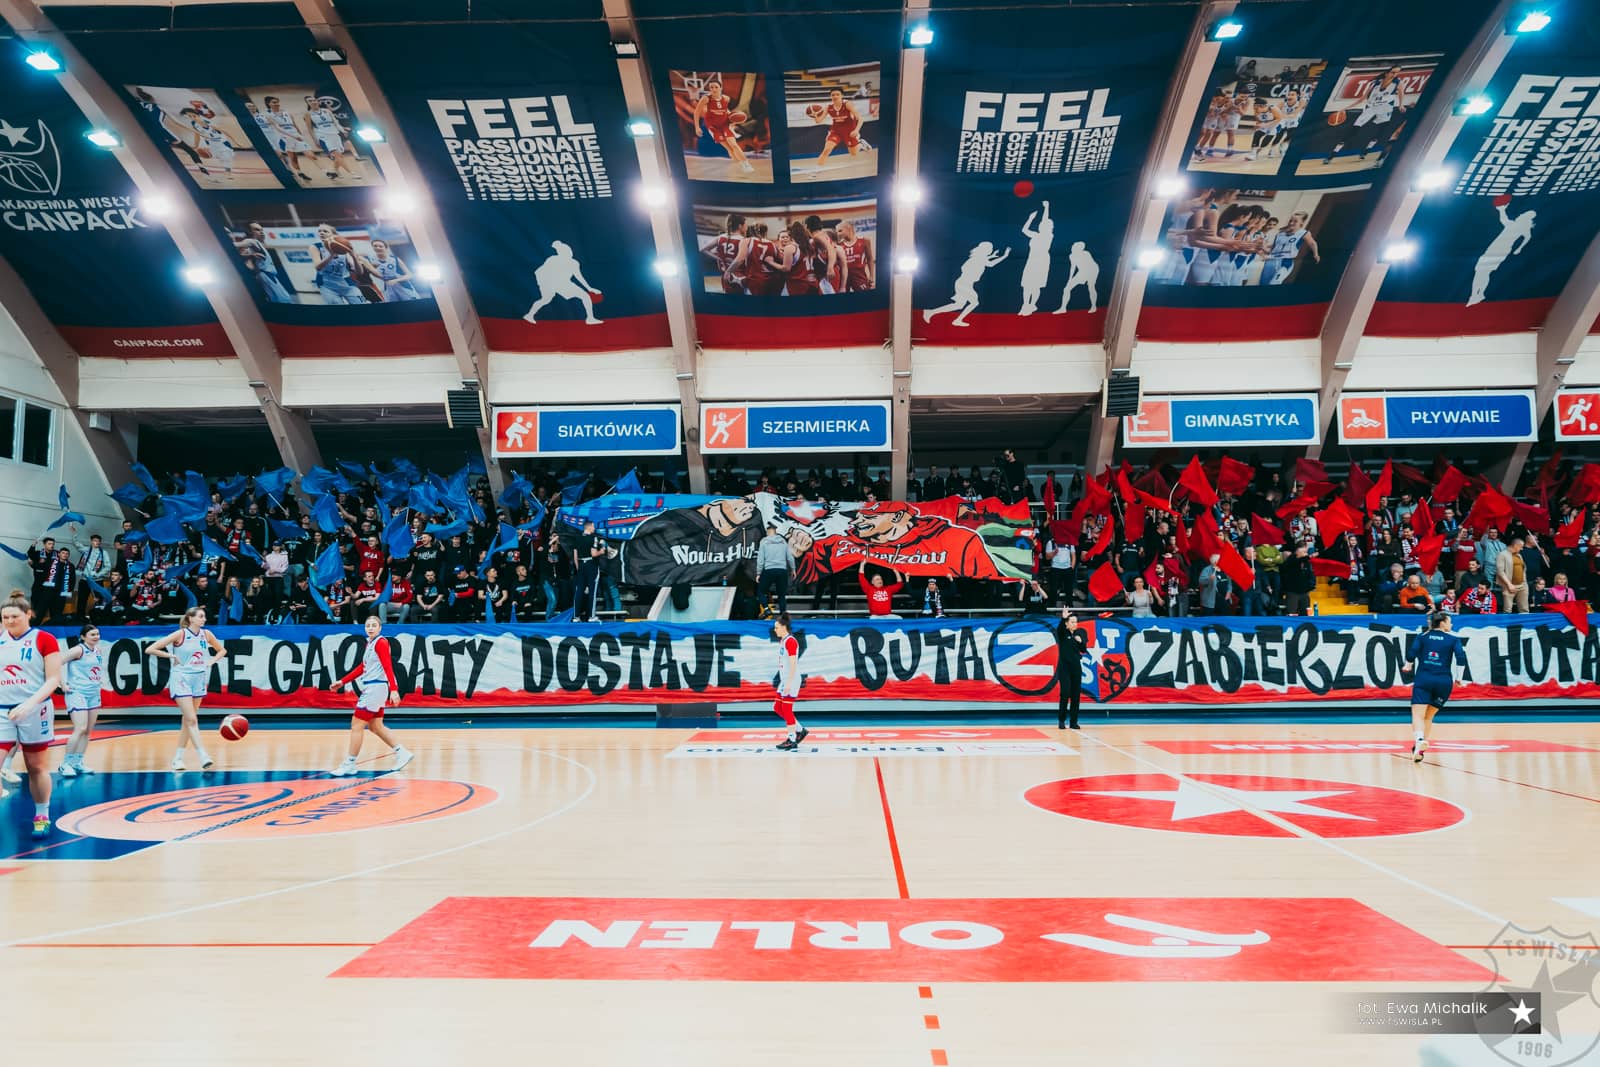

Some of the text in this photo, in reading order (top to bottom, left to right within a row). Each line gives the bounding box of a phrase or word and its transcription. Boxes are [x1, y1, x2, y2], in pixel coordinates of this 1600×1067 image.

[427, 95, 596, 138] FEEL
[961, 87, 1121, 132] FEEL
[960, 126, 1118, 143] PART OF THE TEAM
[1492, 118, 1552, 139] THE
[444, 134, 600, 155] PASSIONATE
[0, 196, 132, 210] KADEMIA WISŁY
[3, 208, 148, 231] CANPACK
[722, 242, 735, 255] 12
[757, 244, 767, 260] 7
[113, 338, 204, 347] CANPACK.COM
[1184, 412, 1300, 428] GIMNASTYKA
[1411, 409, 1501, 424] PŁYWANIE
[557, 422, 657, 438] SIATKÓWKA
[762, 419, 871, 434] SZERMIERKA
[20, 648, 33, 661] 14
[521, 630, 741, 696] DOSTAJE
[850, 625, 986, 691] BUTA
[1489, 624, 1600, 686] HUTA
[528, 919, 1005, 950] ORLEN
